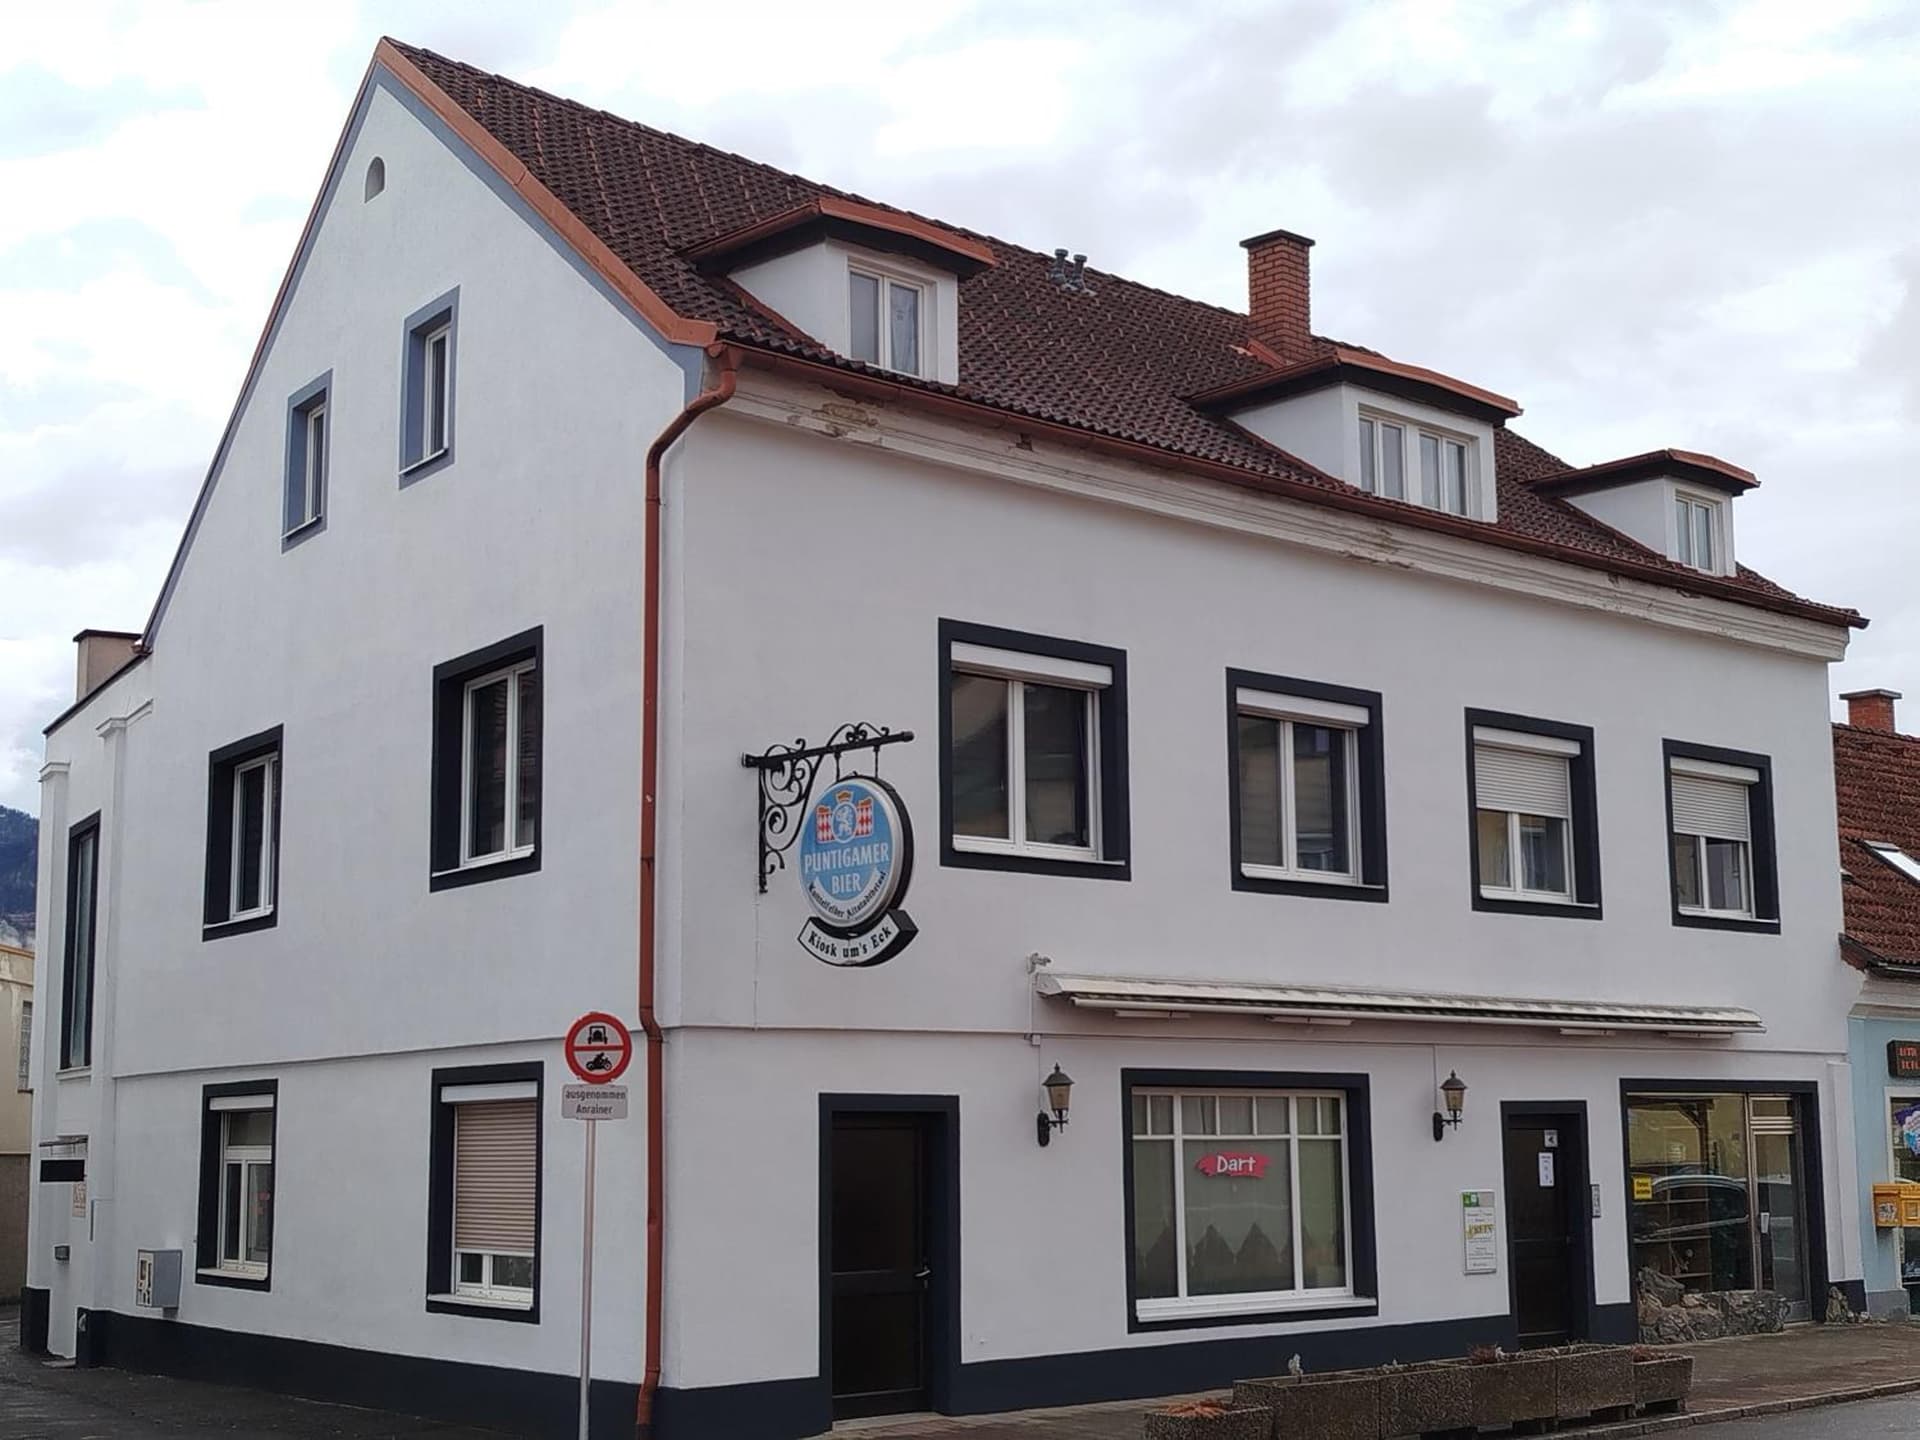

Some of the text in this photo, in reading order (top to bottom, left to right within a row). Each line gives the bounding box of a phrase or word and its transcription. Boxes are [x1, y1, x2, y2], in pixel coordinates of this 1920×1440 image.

[804, 842, 889, 874] PUNTIGAMER
[831, 873, 861, 894] BIER
[808, 926, 892, 958] Kiosk um's Eck
[565, 1090, 626, 1101] ausgenommen
[576, 1103, 613, 1115] Anrainer
[1216, 1155, 1256, 1172] Dart
